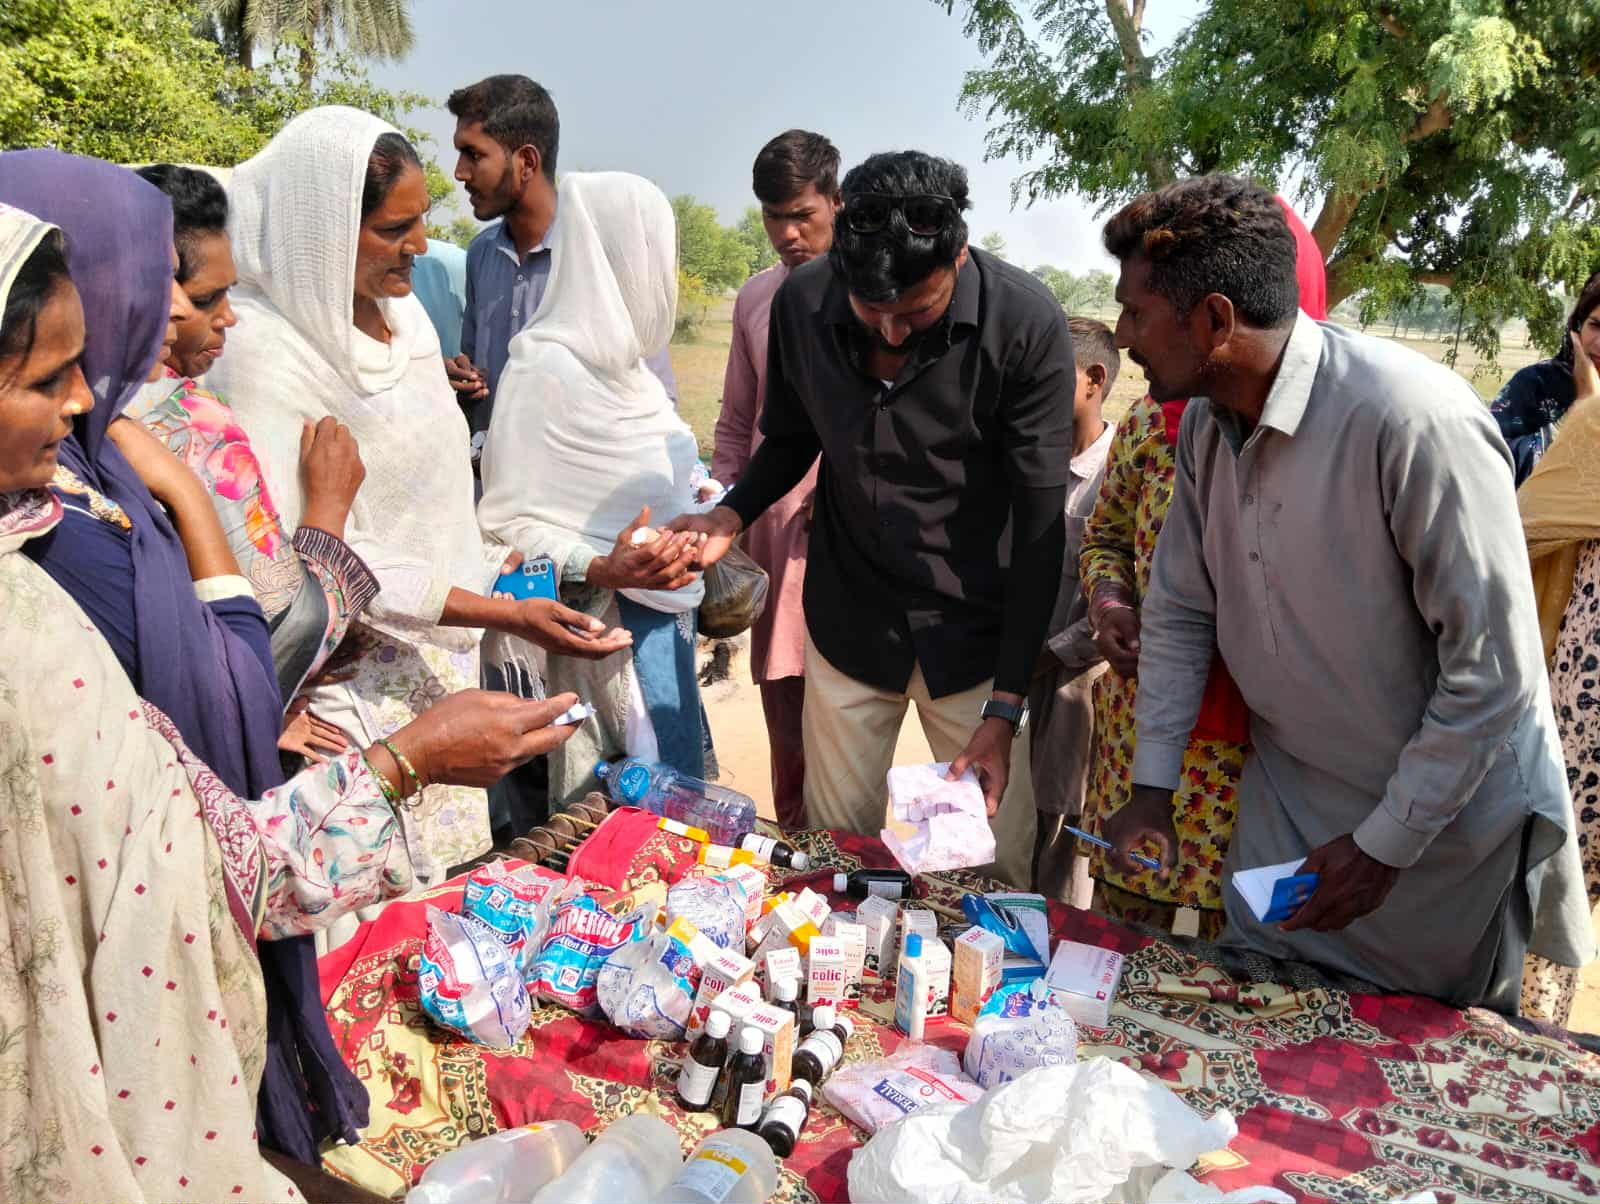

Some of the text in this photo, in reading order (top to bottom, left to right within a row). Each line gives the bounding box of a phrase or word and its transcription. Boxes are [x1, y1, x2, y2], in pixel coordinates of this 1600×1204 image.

[812, 968, 842, 981] colic
[704, 976, 726, 993] coli
[728, 991, 754, 1004] colic
[752, 1012, 778, 1025] colic
[880, 1083, 920, 1113] PERIAL
